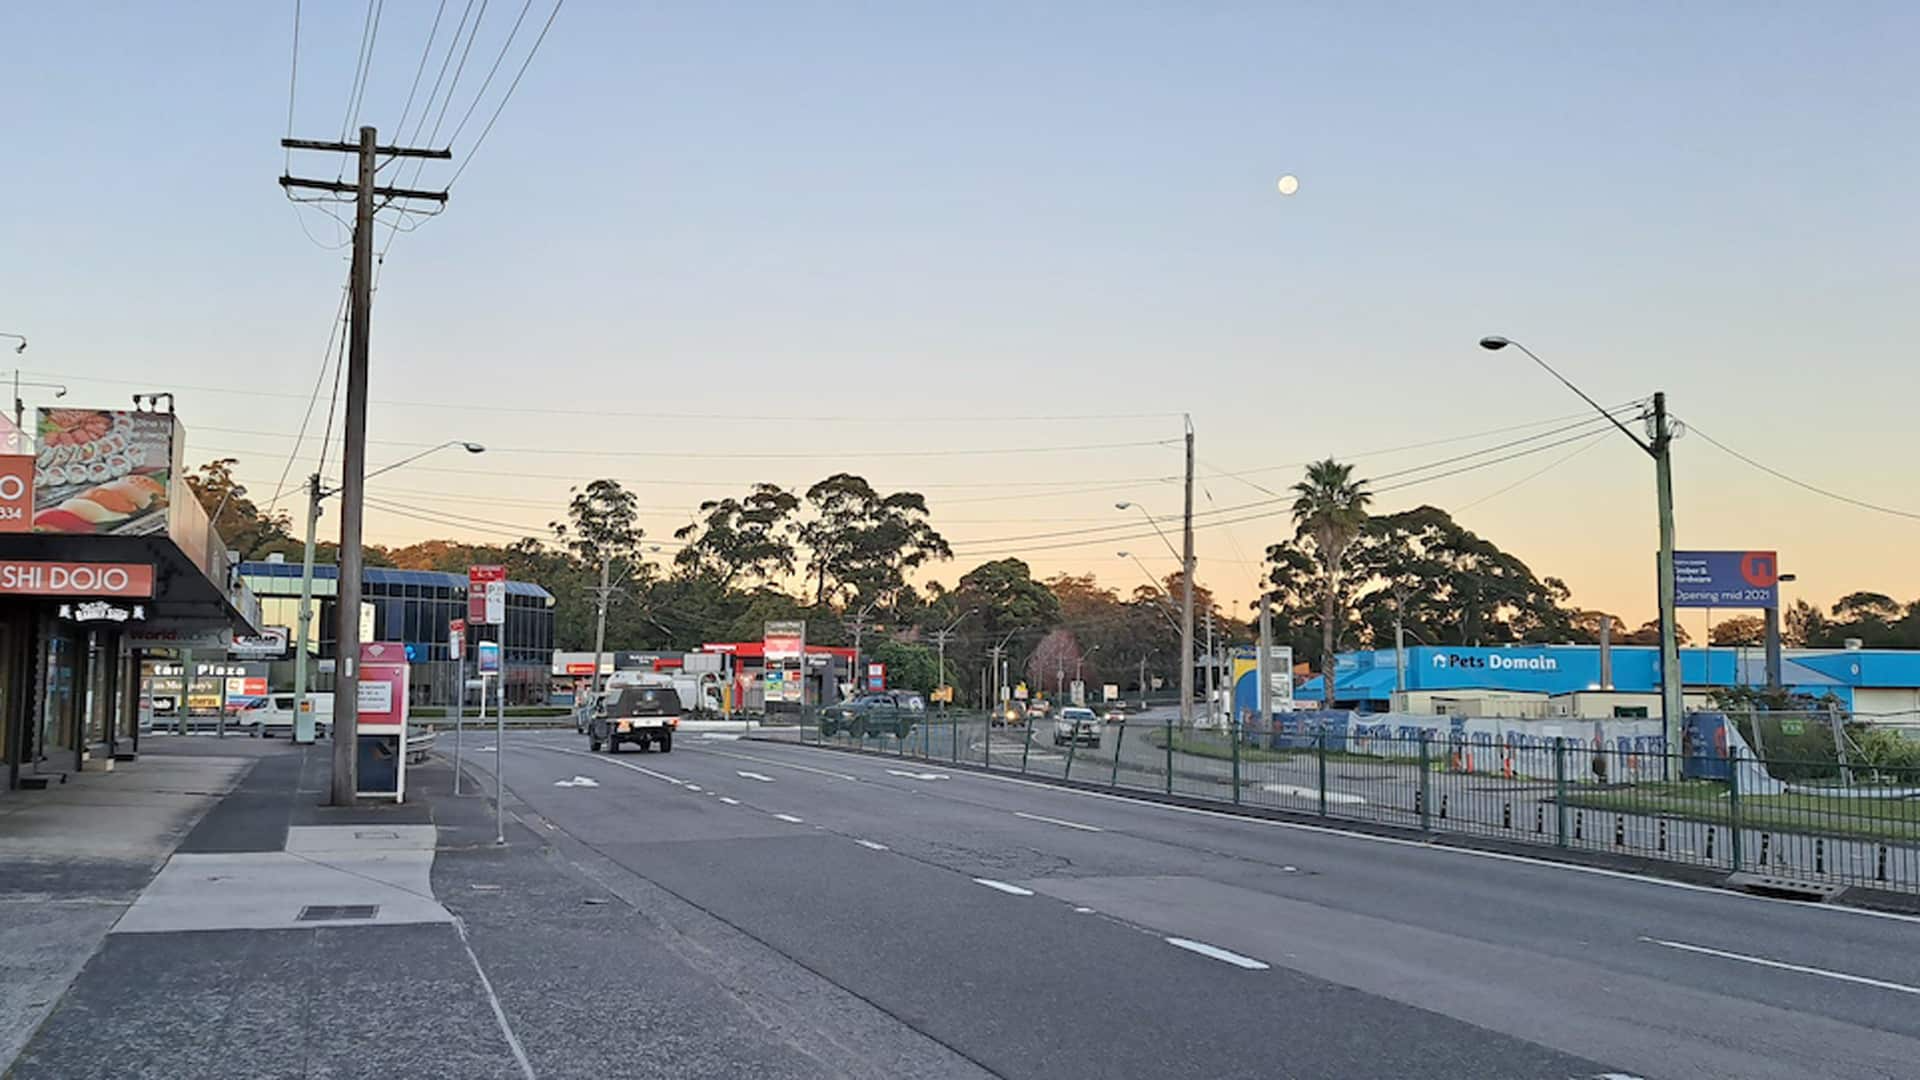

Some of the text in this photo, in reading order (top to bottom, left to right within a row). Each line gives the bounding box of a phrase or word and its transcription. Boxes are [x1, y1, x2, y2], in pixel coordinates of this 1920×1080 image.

[51, 567, 129, 591] DOJO
[1721, 589, 1742, 600] mid
[1744, 589, 1770, 600] 2021
[1450, 654, 1557, 670] Pets Domain
[197, 664, 246, 676] Plaza
